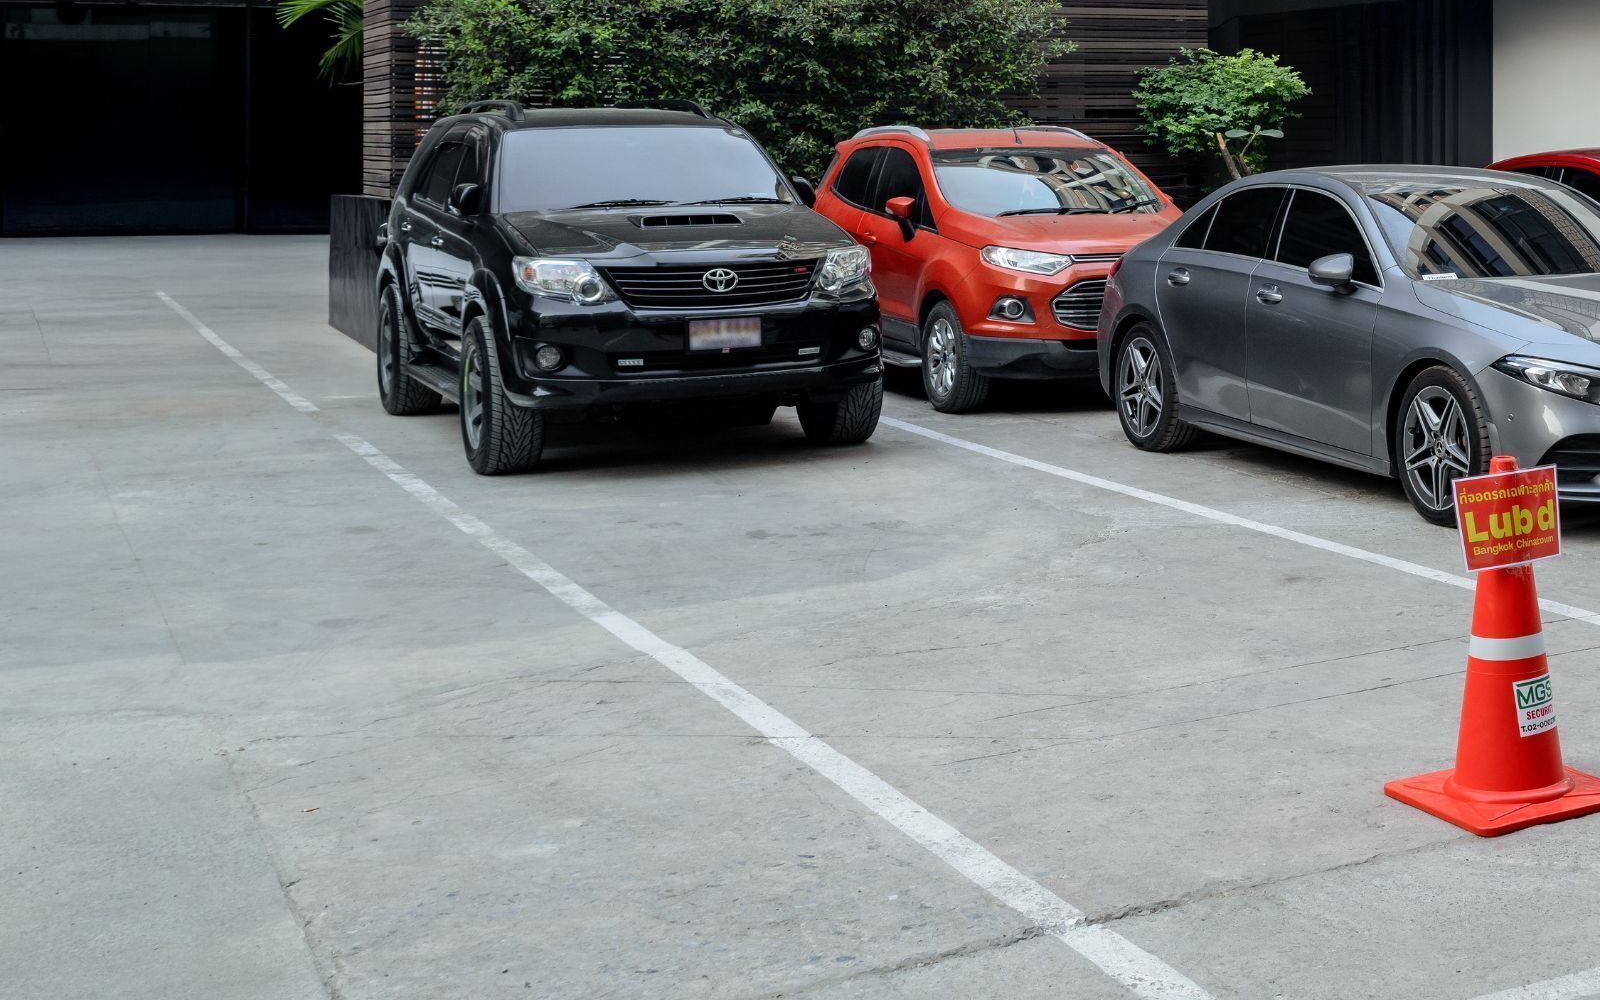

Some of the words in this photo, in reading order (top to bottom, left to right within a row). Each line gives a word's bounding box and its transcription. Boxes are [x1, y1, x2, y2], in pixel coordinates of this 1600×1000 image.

[1472, 542, 1514, 556] Bangkok
[1516, 535, 1554, 549] Chinatown
[1516, 680, 1553, 705] MGS
